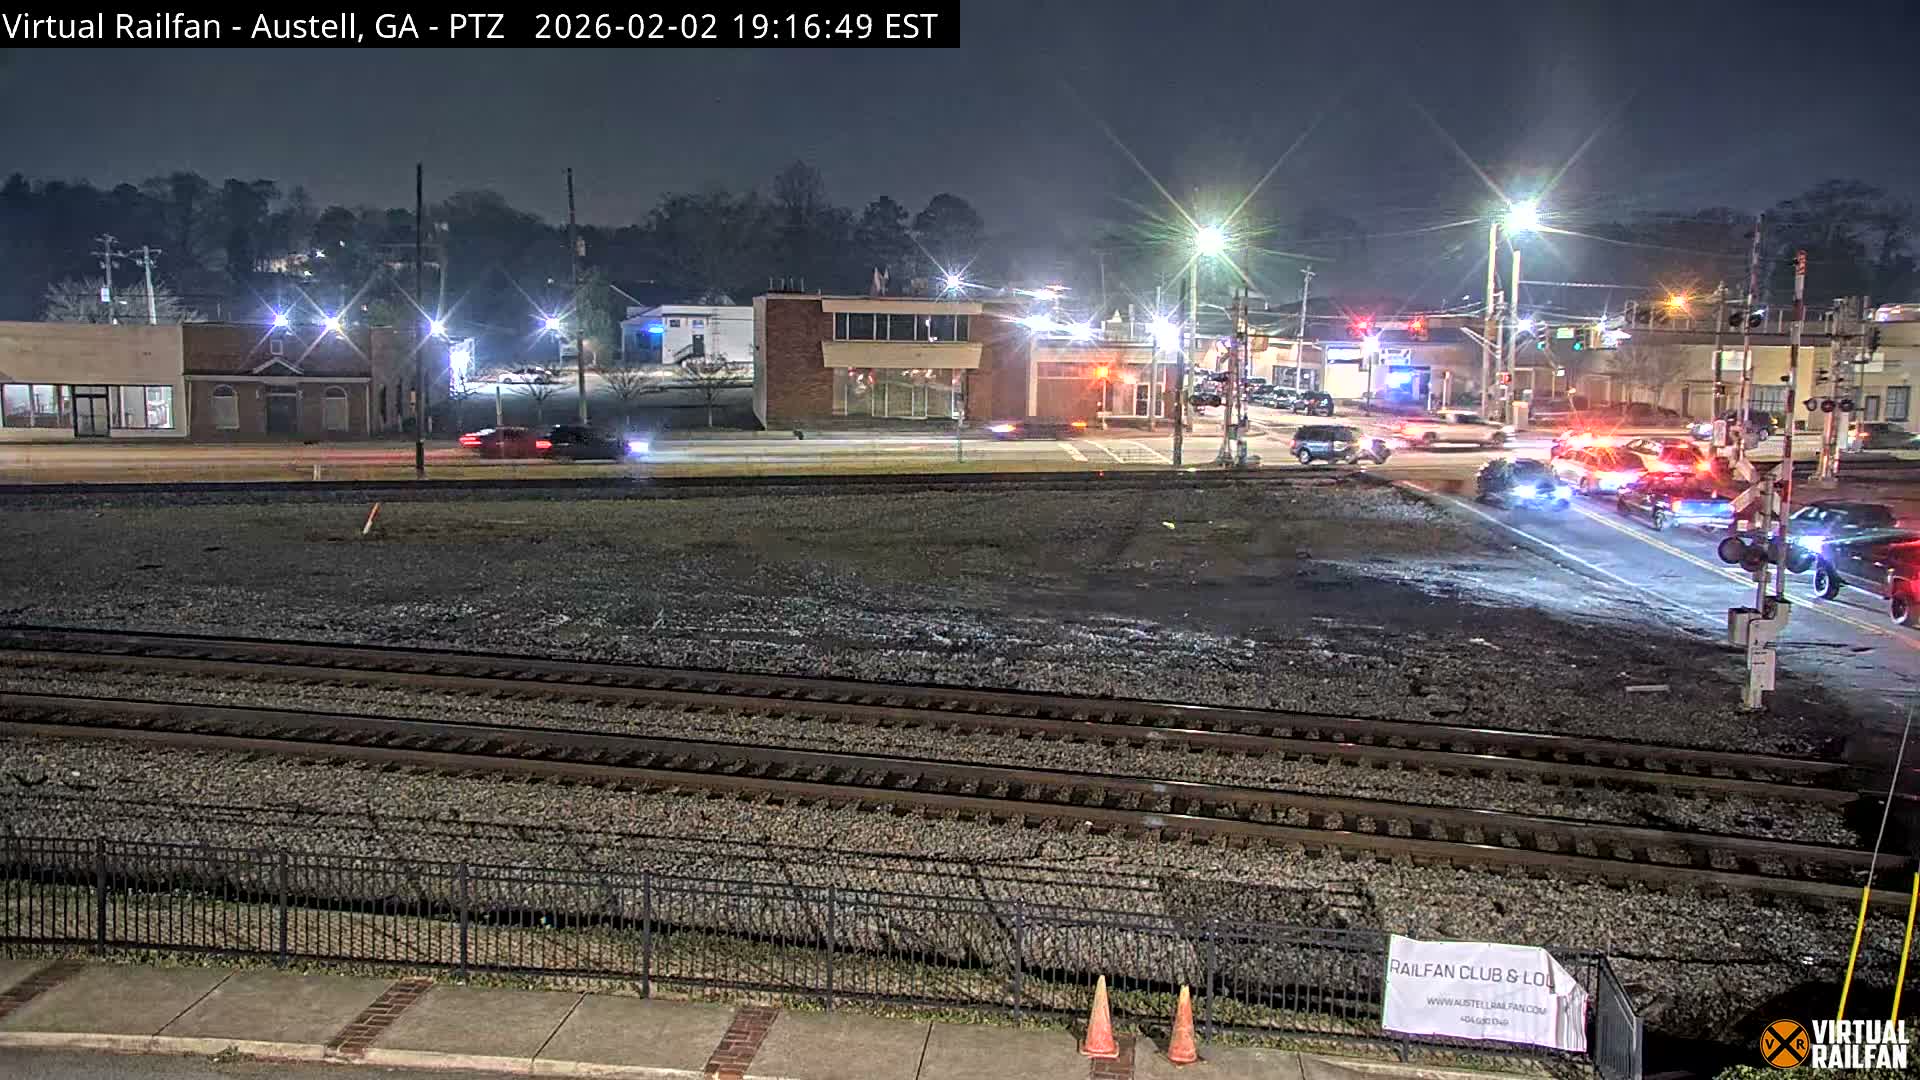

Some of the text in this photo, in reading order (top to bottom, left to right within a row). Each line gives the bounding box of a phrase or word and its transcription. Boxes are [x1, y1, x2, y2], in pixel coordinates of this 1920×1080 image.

[1390, 959, 1455, 977] RAILFAN
[1459, 965, 1502, 983] CLUB
[1506, 968, 1519, 984] &
